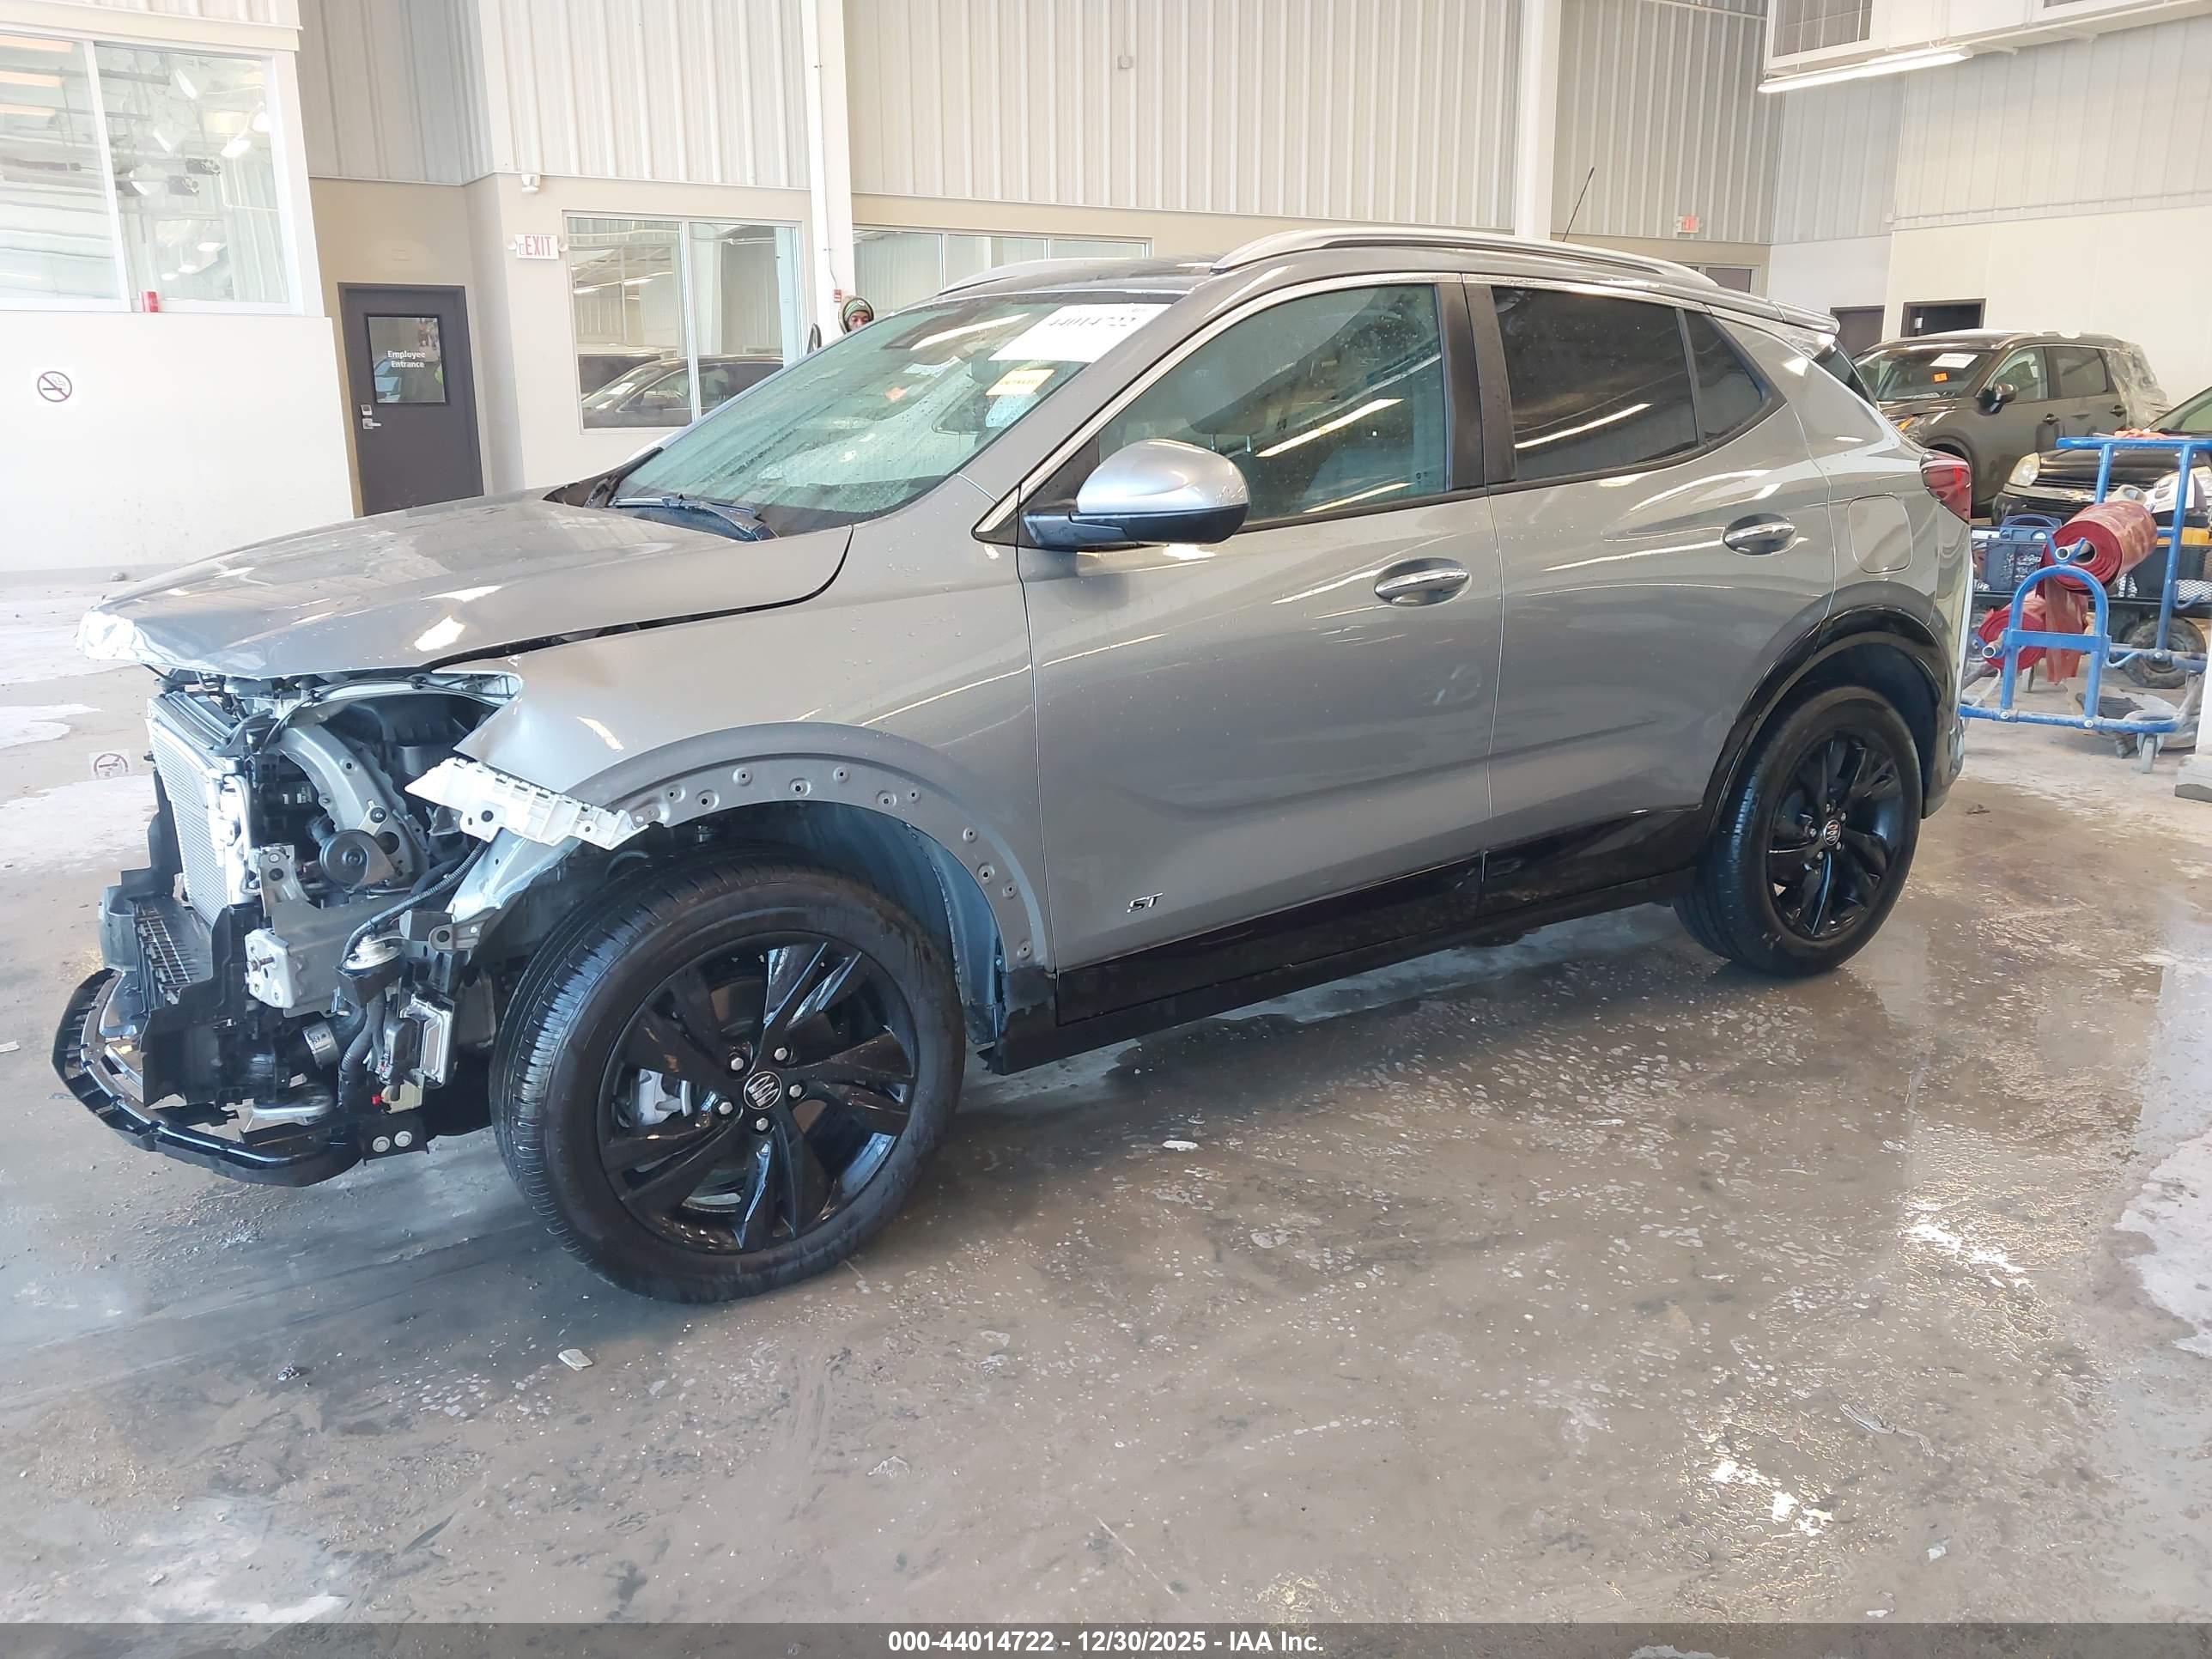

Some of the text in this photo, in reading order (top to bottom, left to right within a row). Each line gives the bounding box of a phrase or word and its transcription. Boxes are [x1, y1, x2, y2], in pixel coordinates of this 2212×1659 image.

[525, 234, 551, 257] EXIT
[387, 350, 426, 360] Employee
[1127, 892, 1164, 914] ST
